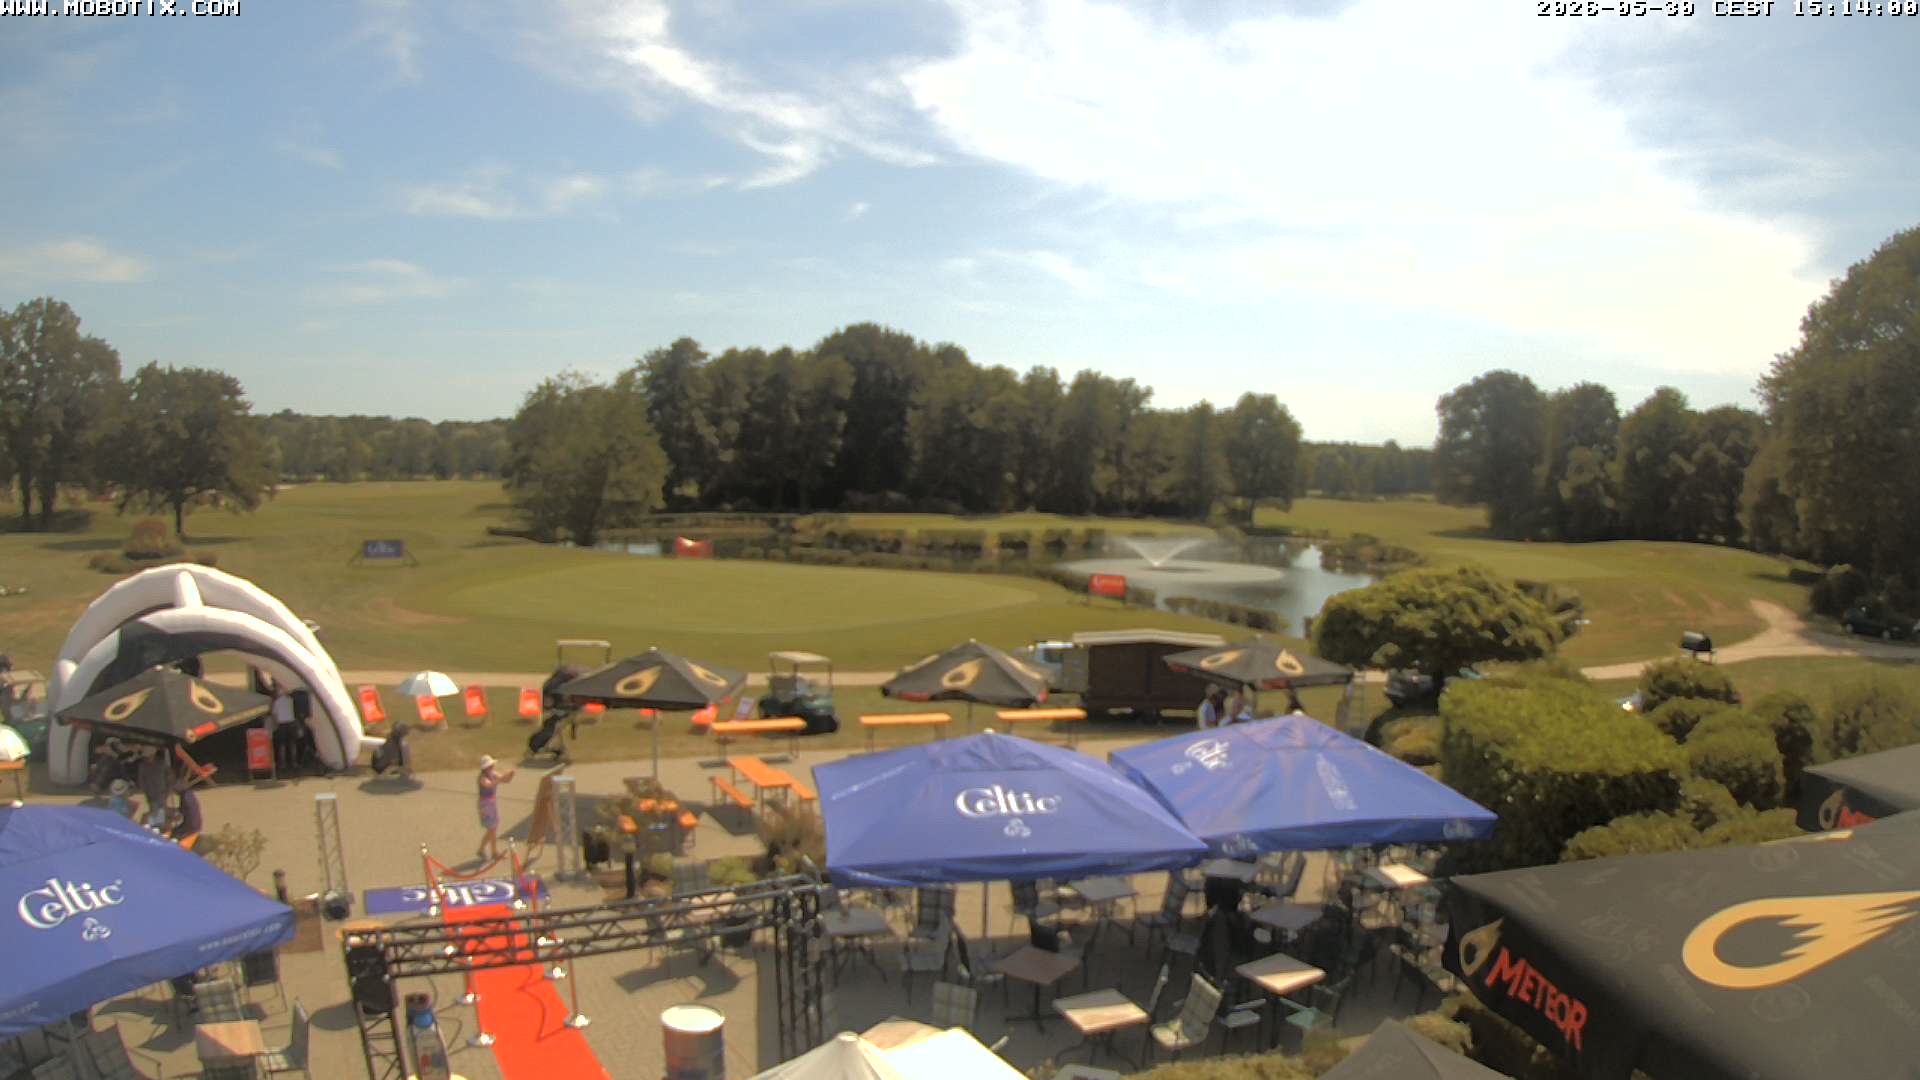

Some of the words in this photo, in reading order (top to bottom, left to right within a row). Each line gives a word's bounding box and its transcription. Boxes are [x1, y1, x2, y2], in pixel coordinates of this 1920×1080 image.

[956, 784, 1059, 818] Celtic
[17, 878, 124, 929] Celtic
[1485, 946, 1588, 1053] METEOR
